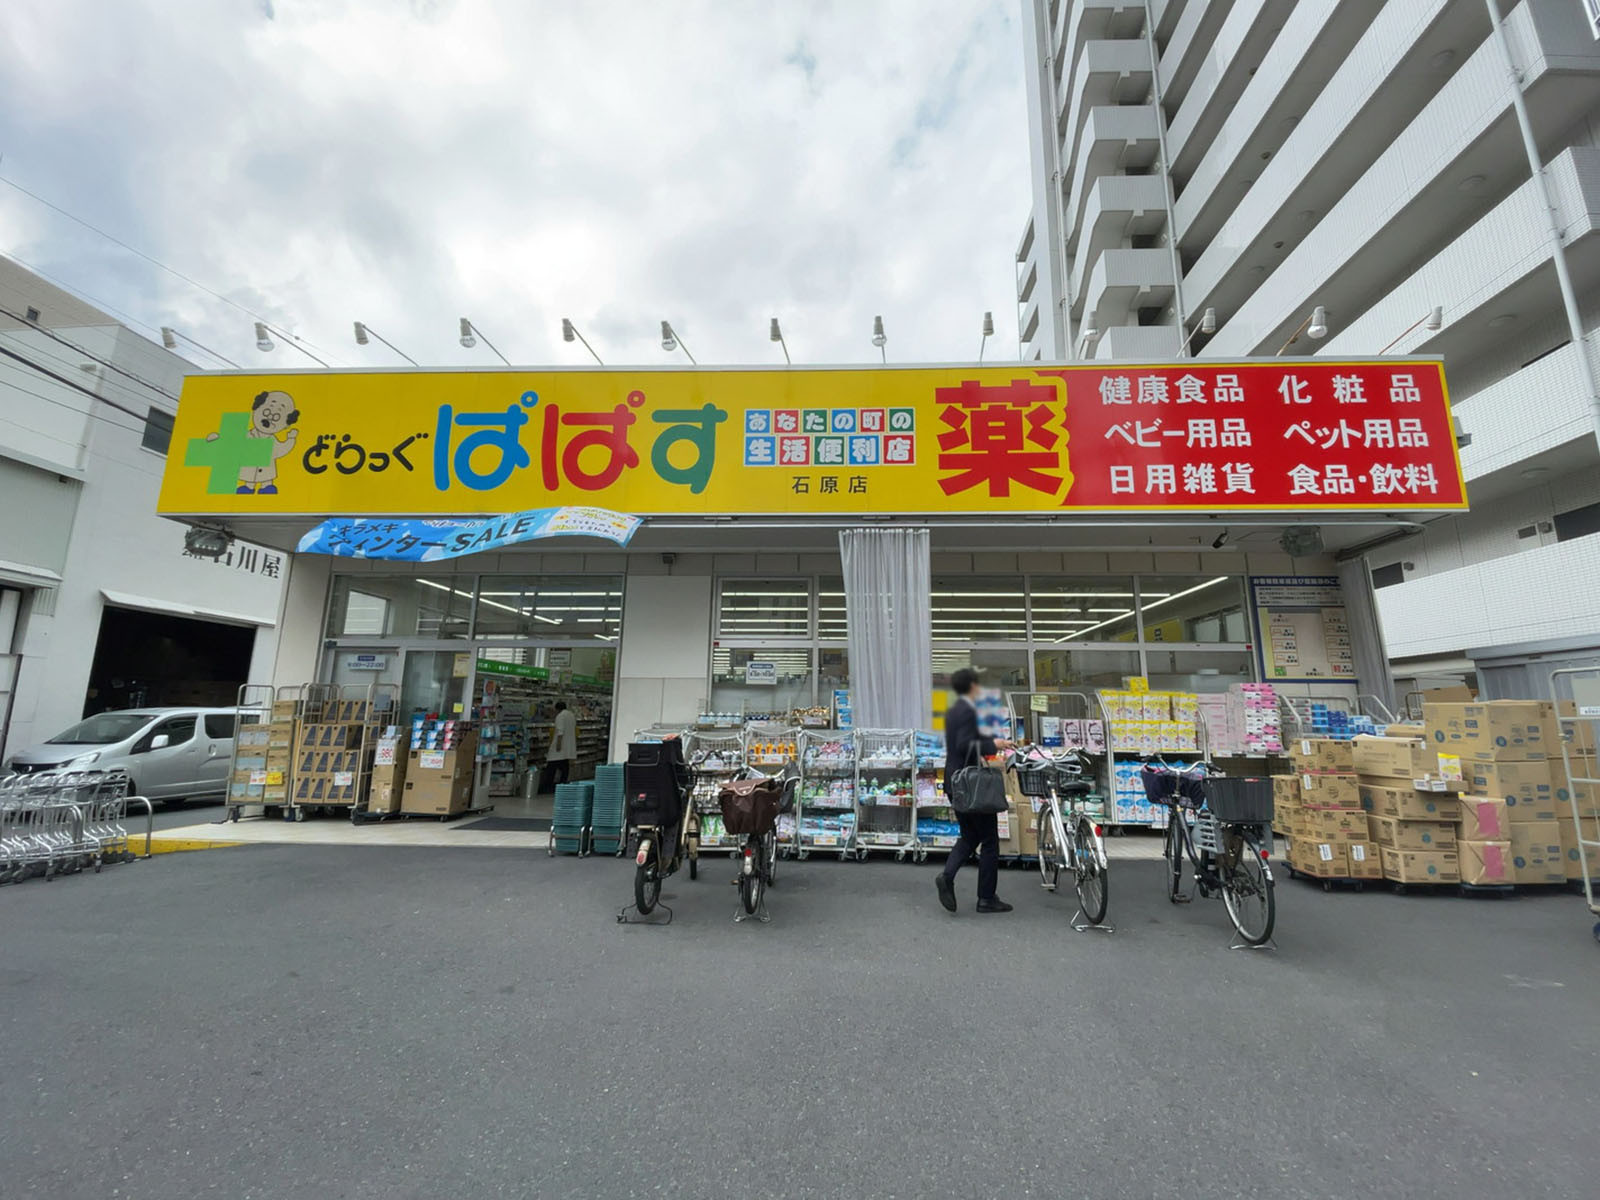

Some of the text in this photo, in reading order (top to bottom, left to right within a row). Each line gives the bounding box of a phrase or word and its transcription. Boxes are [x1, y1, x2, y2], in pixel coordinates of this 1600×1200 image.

[1098, 374, 1245, 405] 健康食品
[1277, 374, 1421, 405] 化粧品
[747, 411, 912, 432] あなたの町の
[1104, 418, 1252, 449] ベビー用品
[1283, 418, 1429, 449] ペット用品
[302, 391, 728, 494] どらっぐ ぱぱす
[747, 437, 912, 463] 生活便利店
[935, 379, 1064, 498] 薬
[791, 475, 868, 494] 石原店
[1110, 462, 1256, 495] 日用雑貨
[1287, 463, 1438, 495] 食品・飲料
[450, 516, 536, 552] SALE
